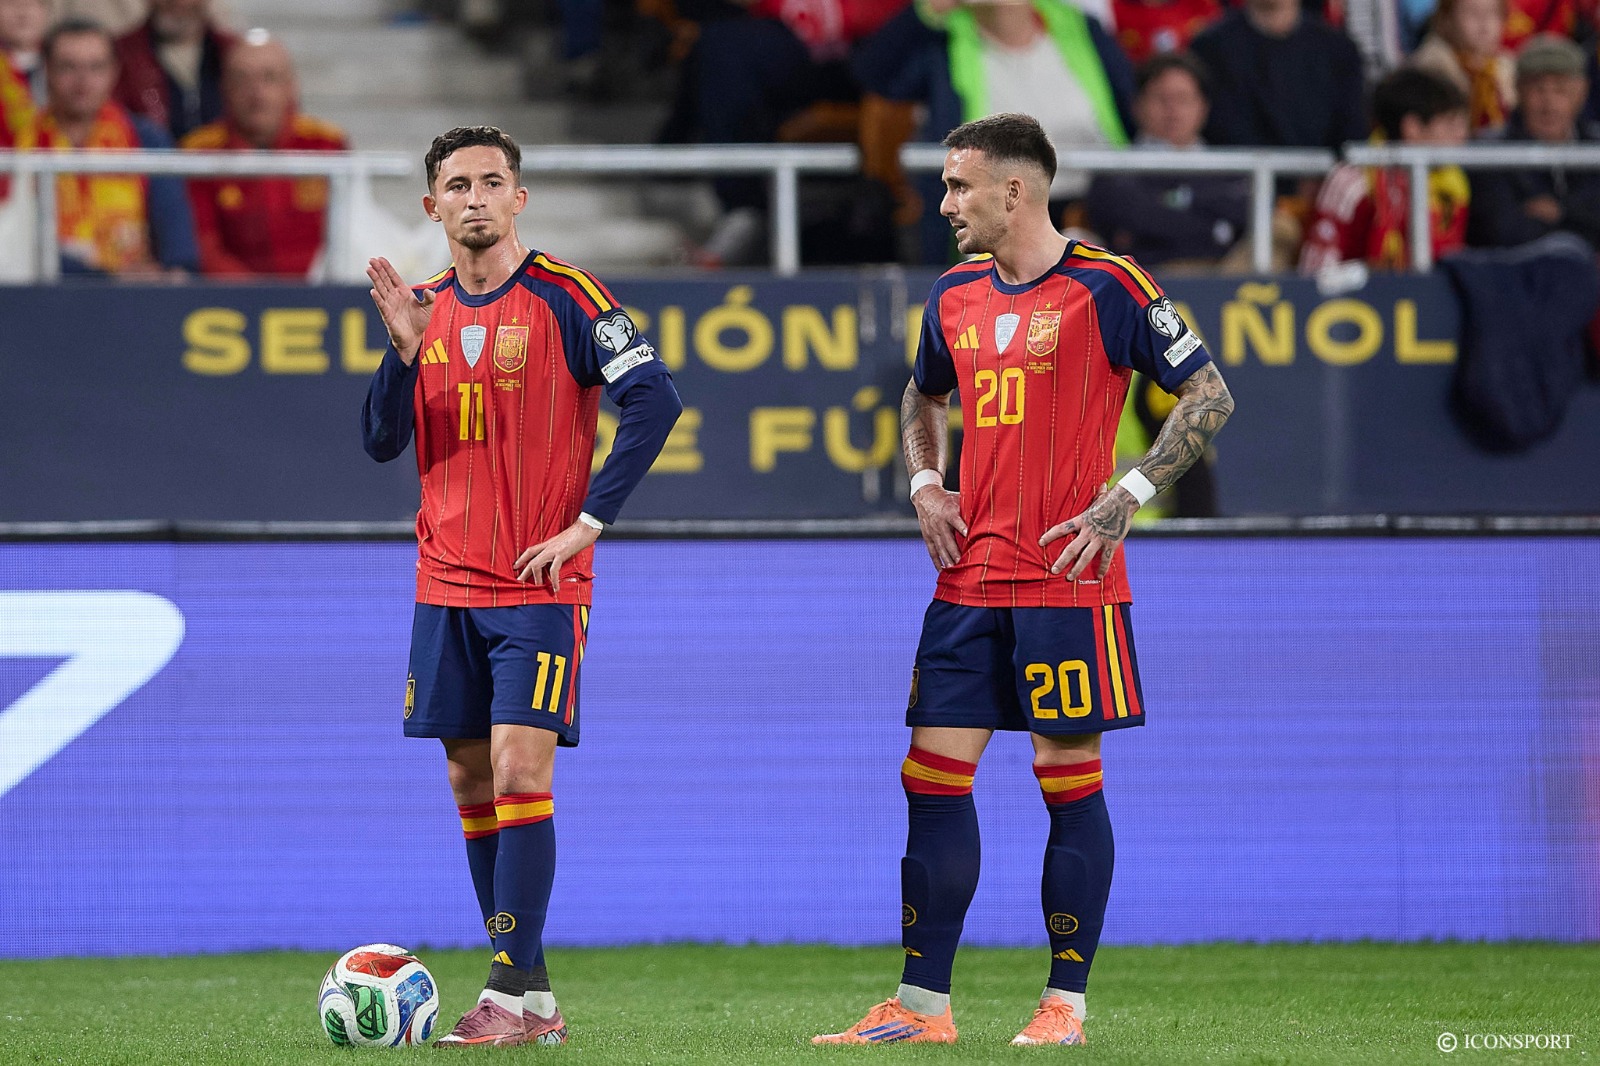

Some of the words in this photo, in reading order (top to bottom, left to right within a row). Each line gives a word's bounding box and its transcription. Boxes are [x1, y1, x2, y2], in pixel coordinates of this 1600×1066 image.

[182, 286, 859, 375] SELIÓN
[457, 383, 485, 441] 11
[974, 367, 1025, 428] 20
[531, 651, 567, 714] 11
[1024, 659, 1093, 720] 20
